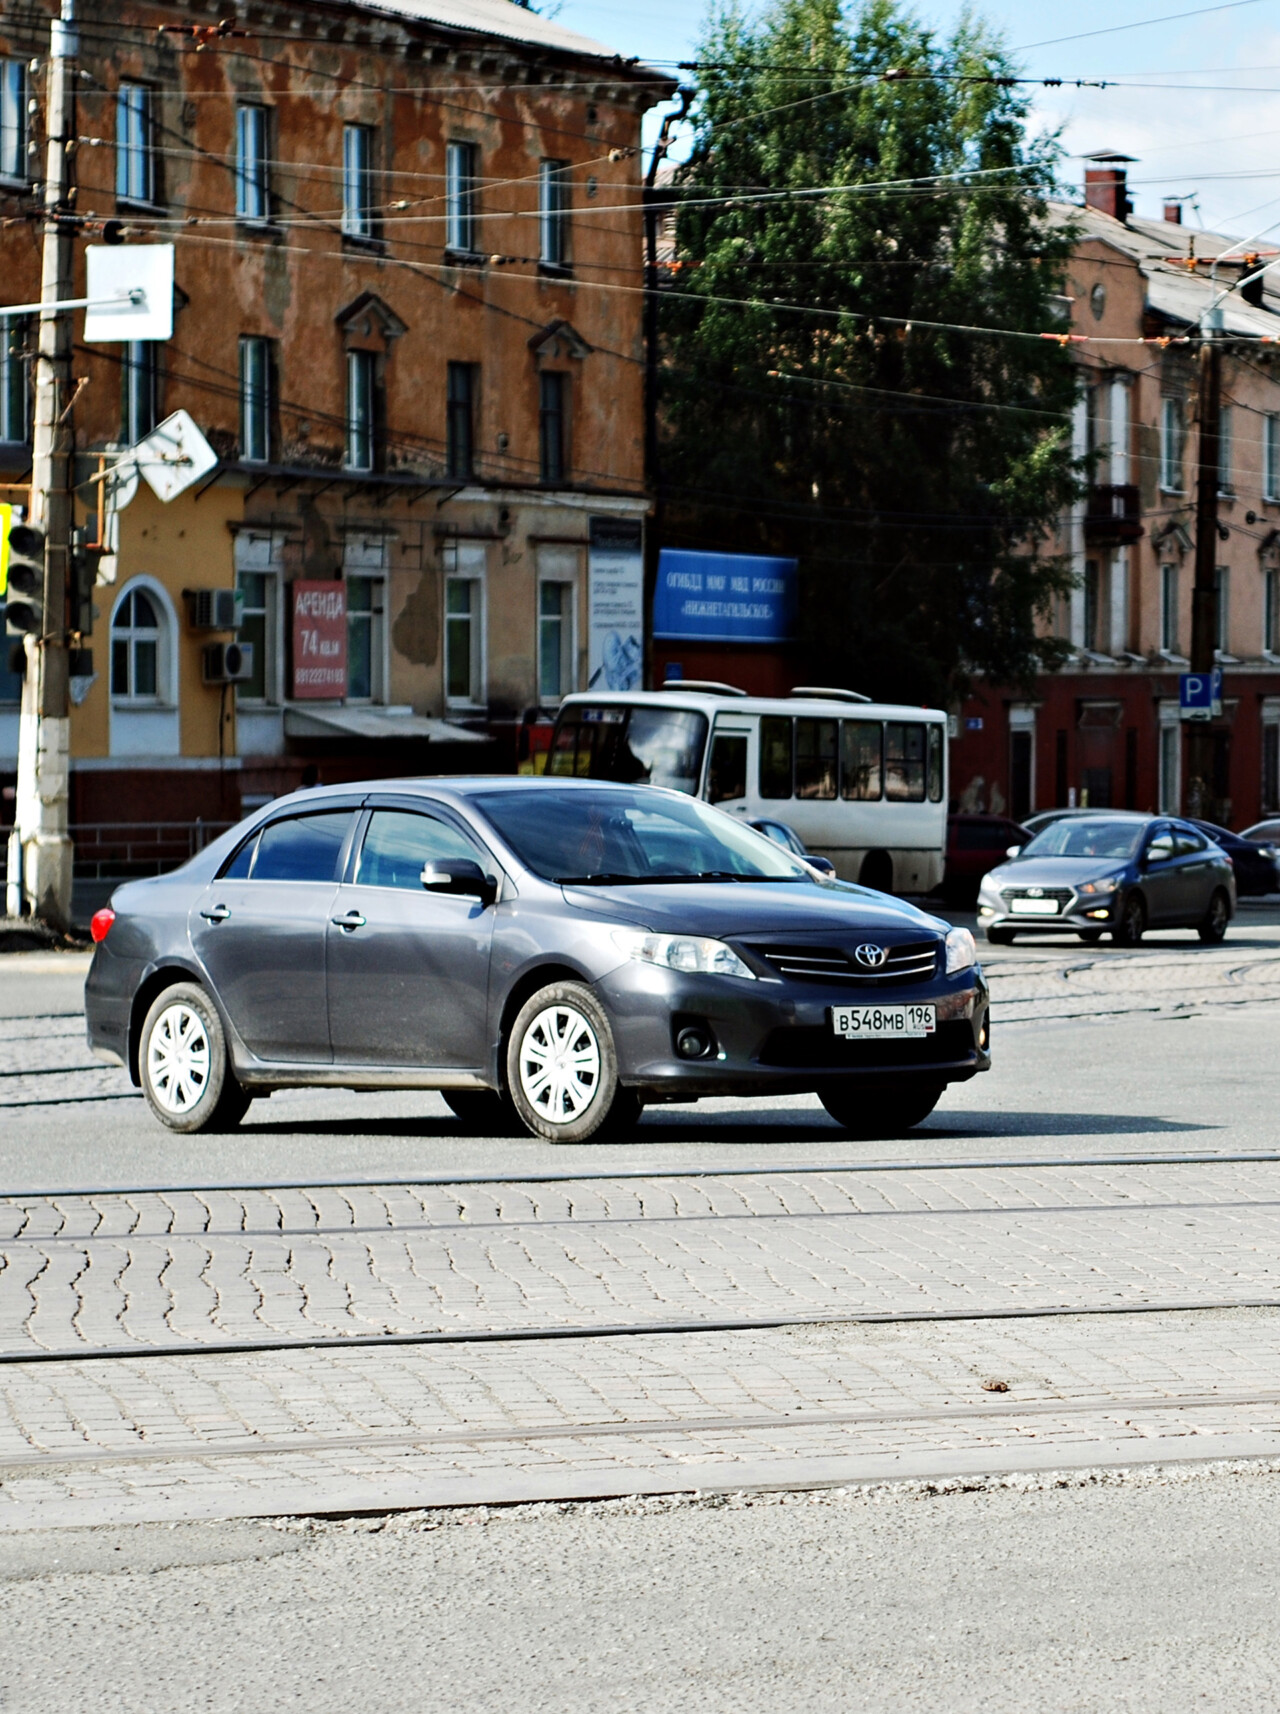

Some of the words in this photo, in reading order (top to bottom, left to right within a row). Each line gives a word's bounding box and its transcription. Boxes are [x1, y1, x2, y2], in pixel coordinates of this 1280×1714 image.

[730, 576, 749, 594] МВД
[752, 577, 785, 595] РОССИИ
[295, 591, 344, 621] АРЕНДА
[301, 630, 319, 656] 74
[1186, 677, 1203, 702] P
[908, 1006, 933, 1024] 196
